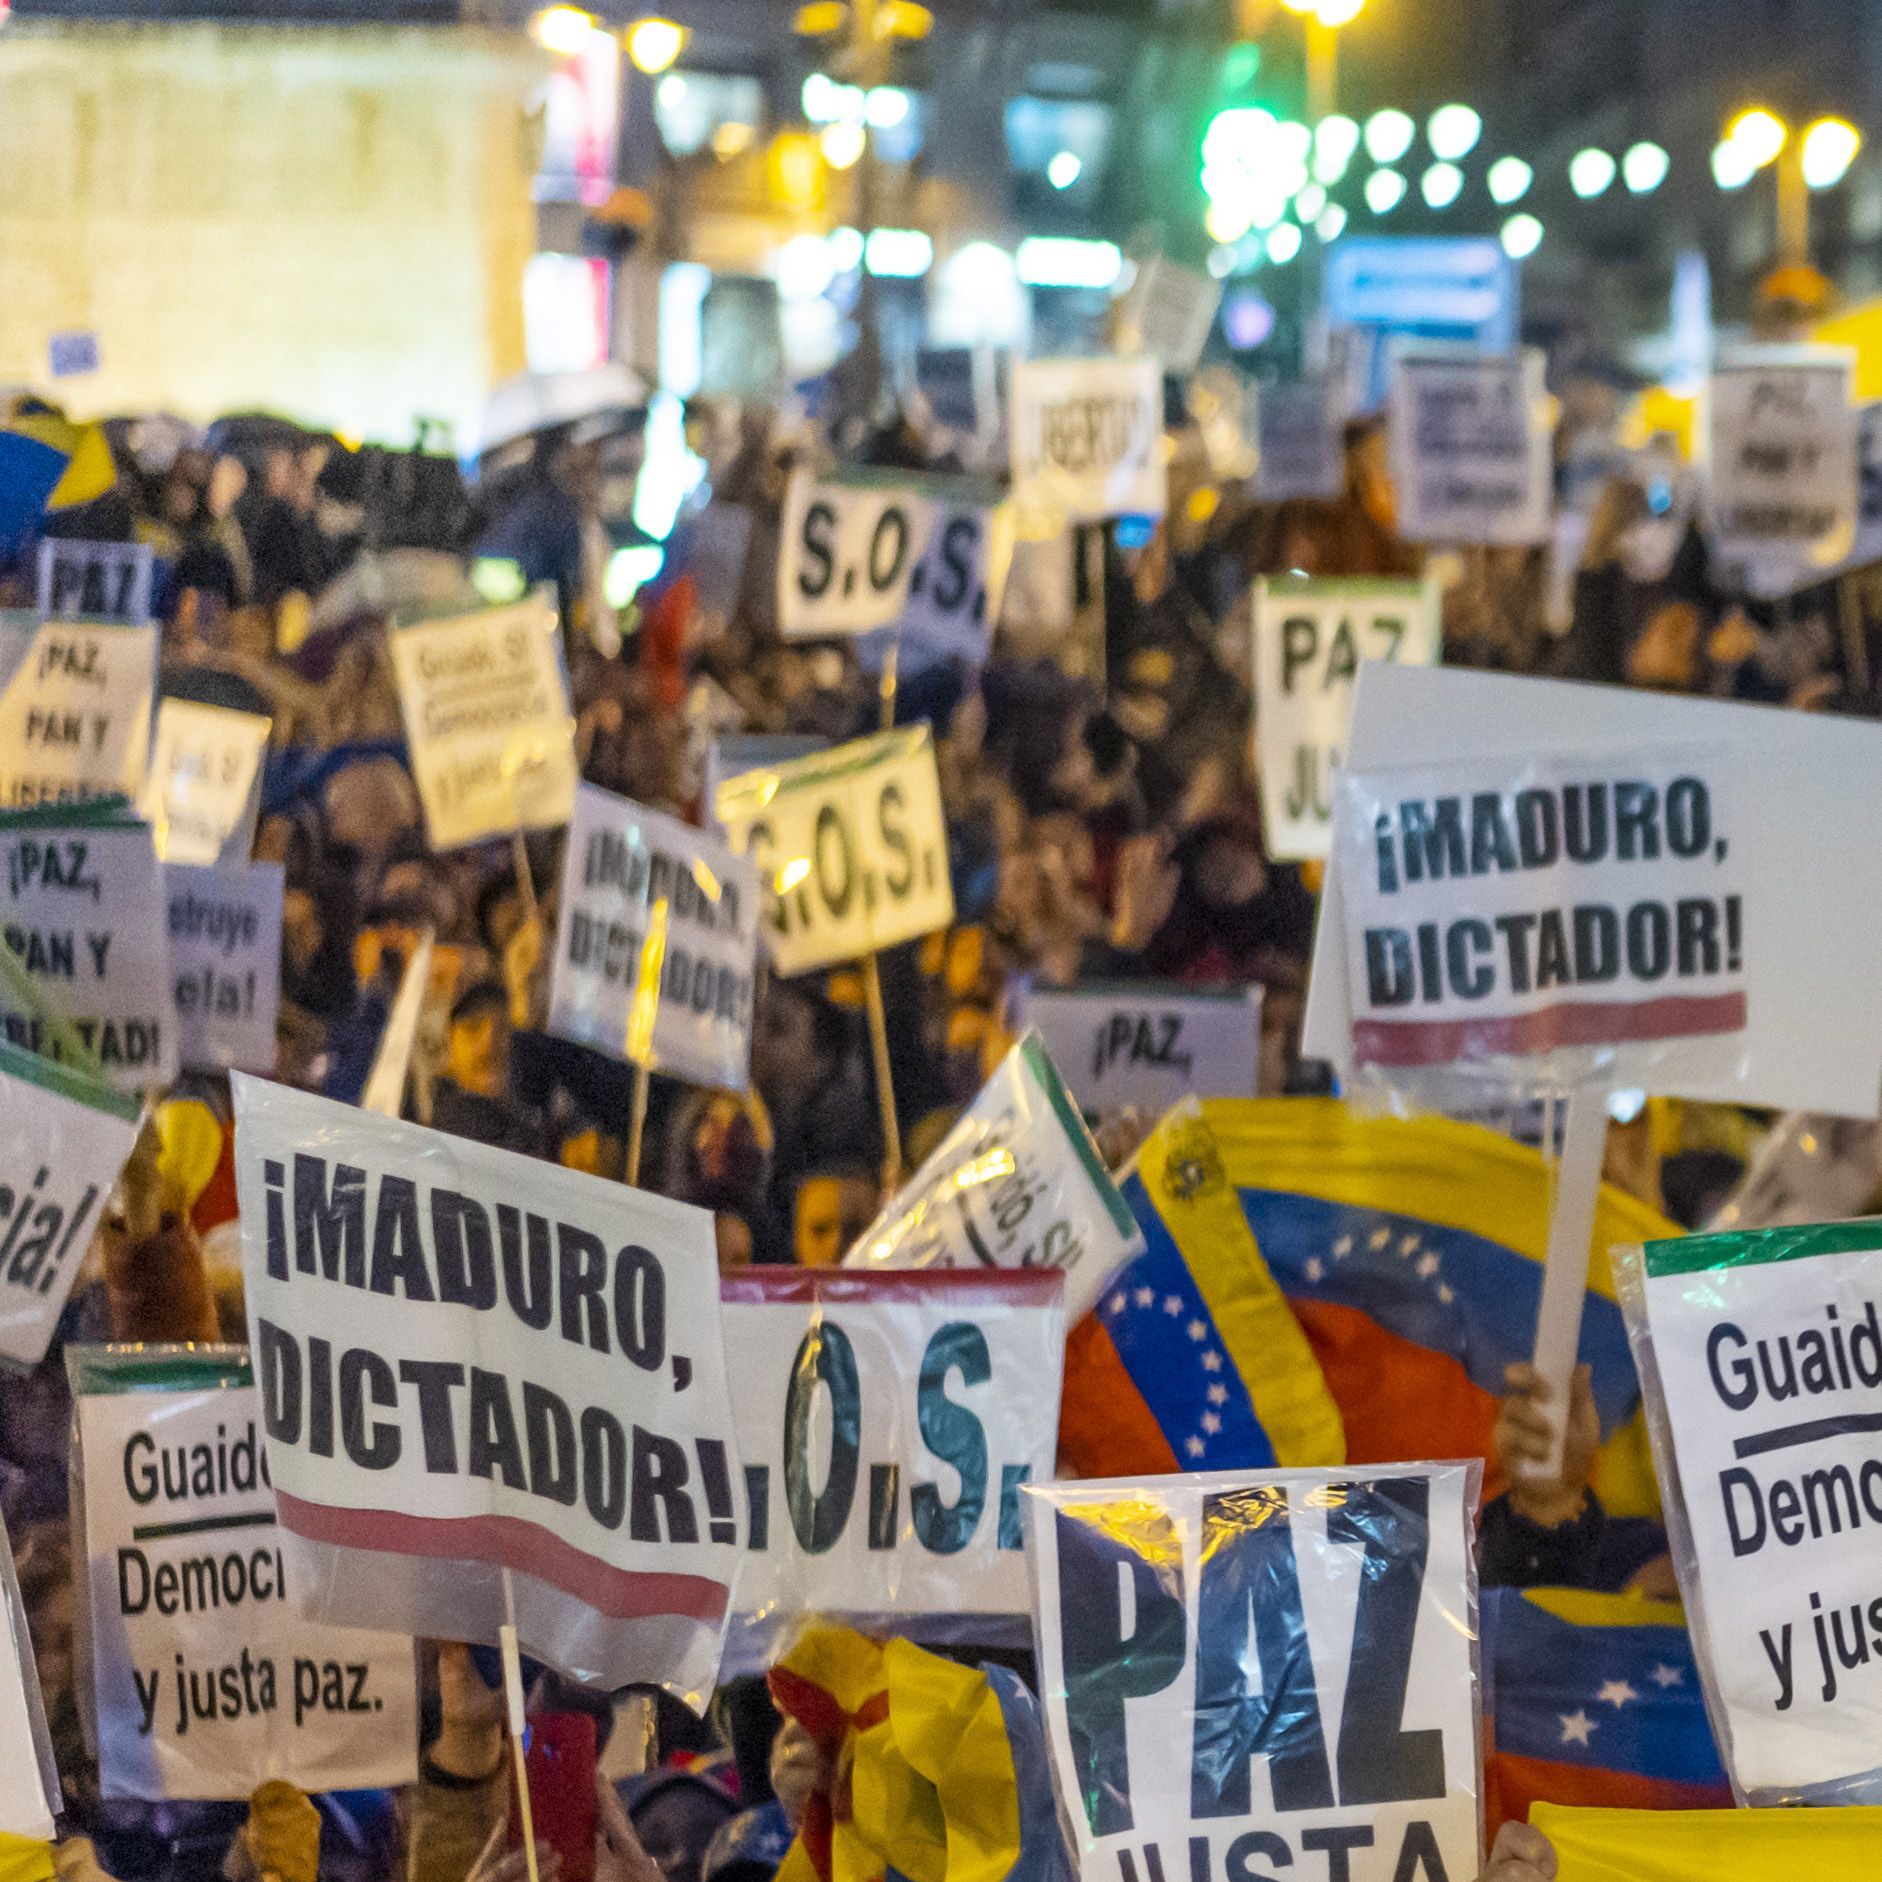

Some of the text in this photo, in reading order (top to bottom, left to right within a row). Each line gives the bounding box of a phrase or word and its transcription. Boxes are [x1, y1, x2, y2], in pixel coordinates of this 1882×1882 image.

[797, 503, 986, 627] S.O.S.
[27, 712, 110, 752] PAN Y
[1376, 776, 1729, 894] ¡MADURO,
[87, 931, 113, 979] Y
[1364, 894, 1744, 1008] DICTADOR!
[1093, 1012, 1192, 1079] ¡PAZ,
[263, 1152, 694, 1393] ¡MADURO,
[259, 1316, 738, 1547] DICTADOR!
[133, 1647, 384, 1736] y justa paz.
[1056, 1474, 1447, 1839] PAZ
[1759, 1622, 1794, 1712] y
